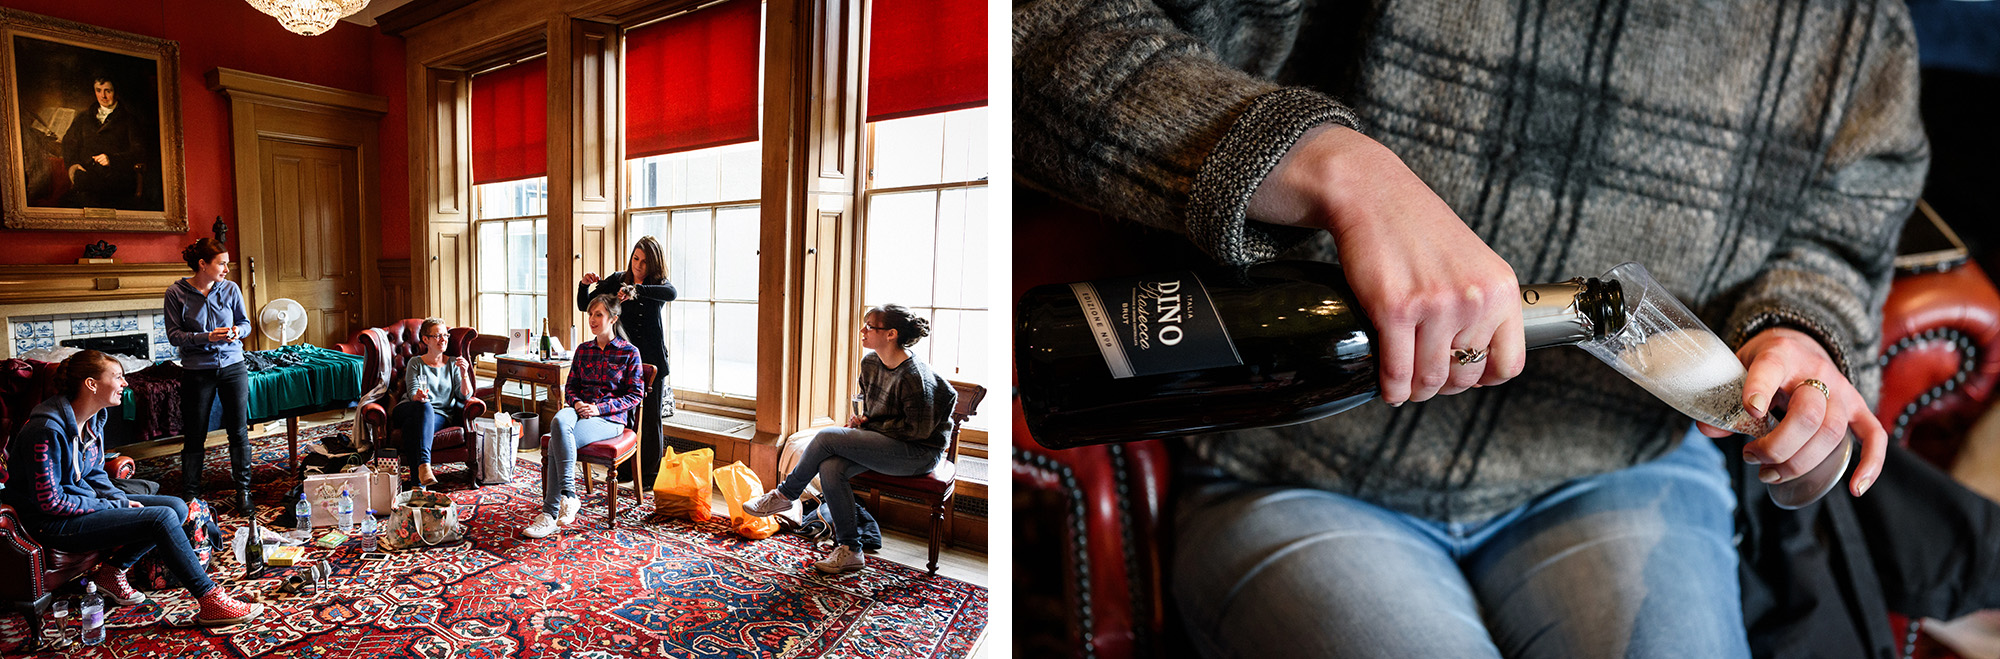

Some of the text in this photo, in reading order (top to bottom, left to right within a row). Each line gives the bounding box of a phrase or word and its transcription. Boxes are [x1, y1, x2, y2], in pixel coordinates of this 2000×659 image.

[1082, 292, 1104, 328] EDIZIONE
[1122, 302, 1130, 325] BRUT
[1137, 281, 1164, 350] Prosecco
[1157, 280, 1184, 346] DINO
[1186, 294, 1194, 319] ITALIA
[34, 440, 49, 462] CO.
